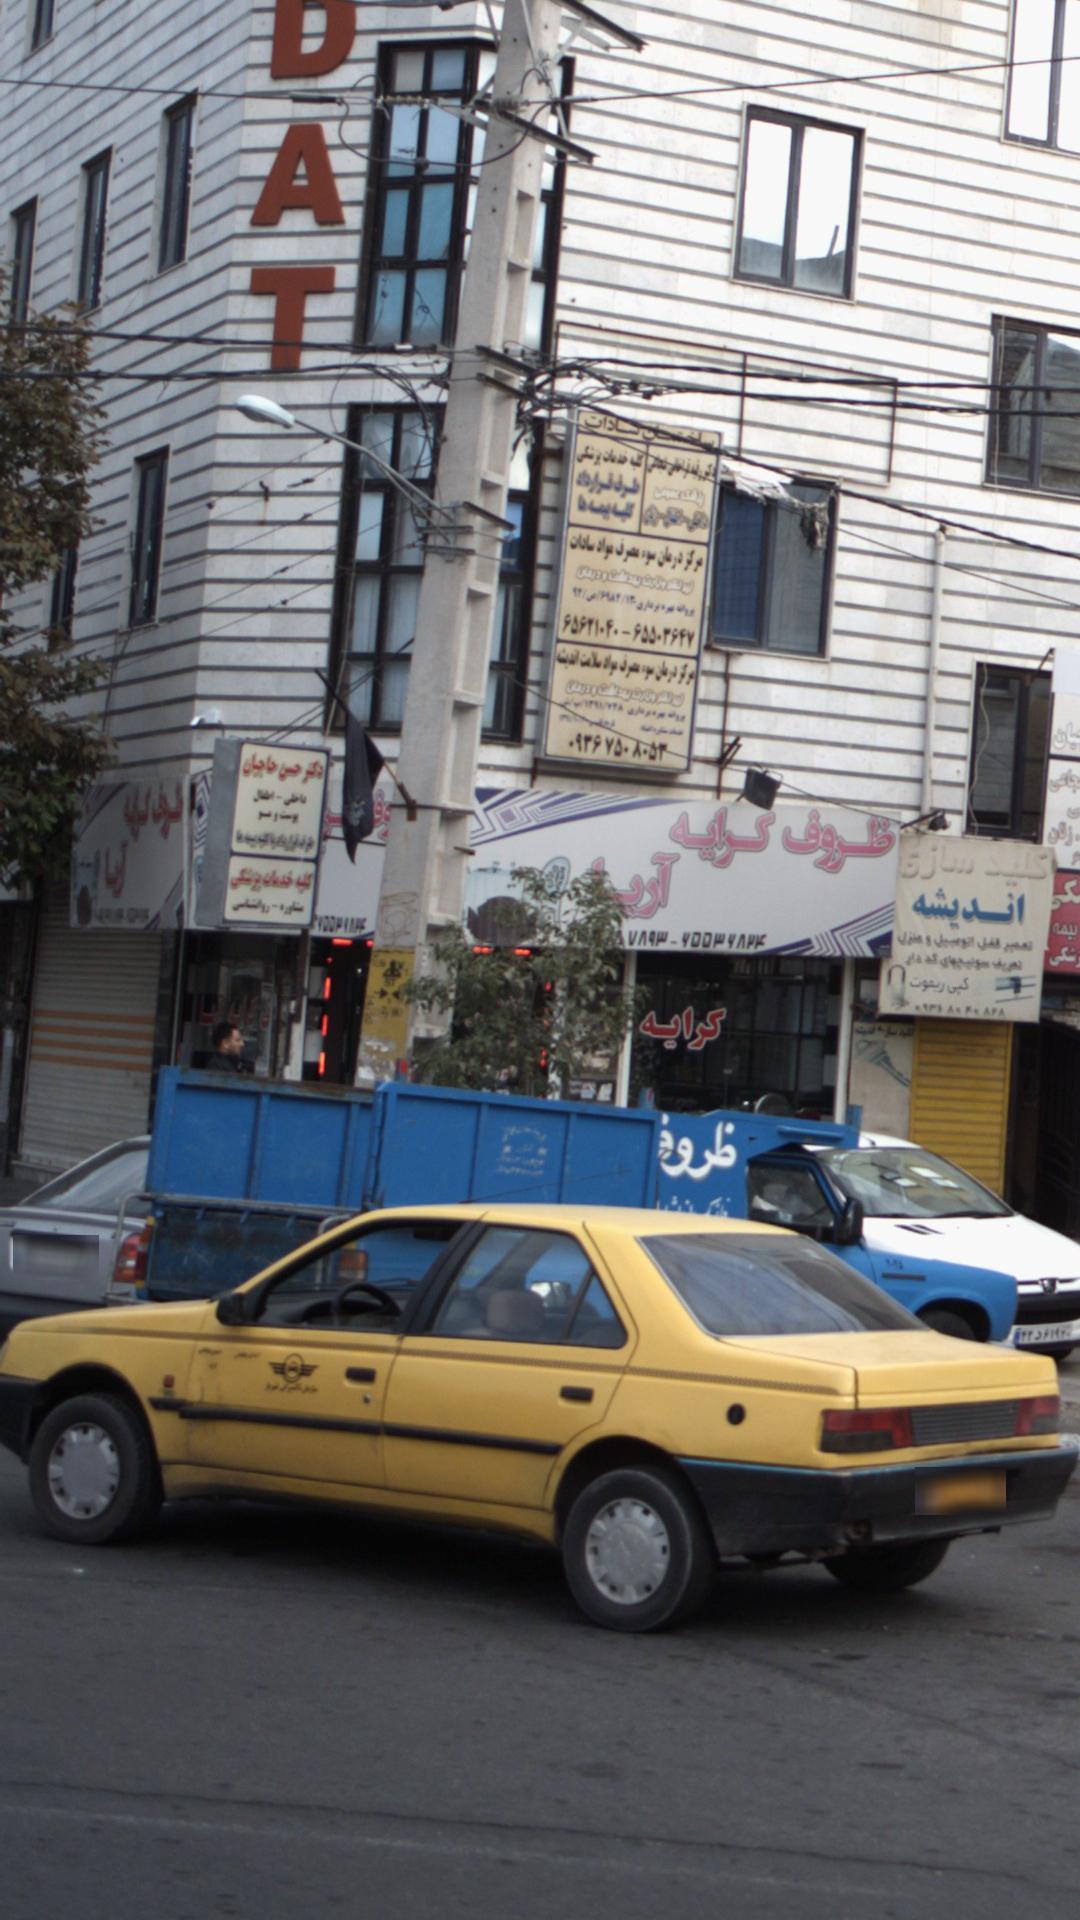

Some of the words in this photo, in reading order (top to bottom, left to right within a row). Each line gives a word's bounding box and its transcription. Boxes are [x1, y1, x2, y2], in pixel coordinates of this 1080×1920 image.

[596, 537, 614, 560] مواد
[615, 540, 640, 562] مصرف
[657, 546, 684, 570] درمان
[684, 550, 704, 572] مرکز
[632, 622, 696, 649] ۶۵۵۰۳۶۴۷
[602, 653, 619, 676] مواد
[619, 654, 641, 679] مصرف
[655, 660, 679, 682] درمان
[678, 663, 695, 685] مرکز
[302, 760, 324, 784] دکتر
[668, 806, 777, 869] کرایه
[782, 807, 898, 874] ظروف
[911, 887, 1026, 931] اندیشه
[638, 1005, 727, 1050] کرایه
